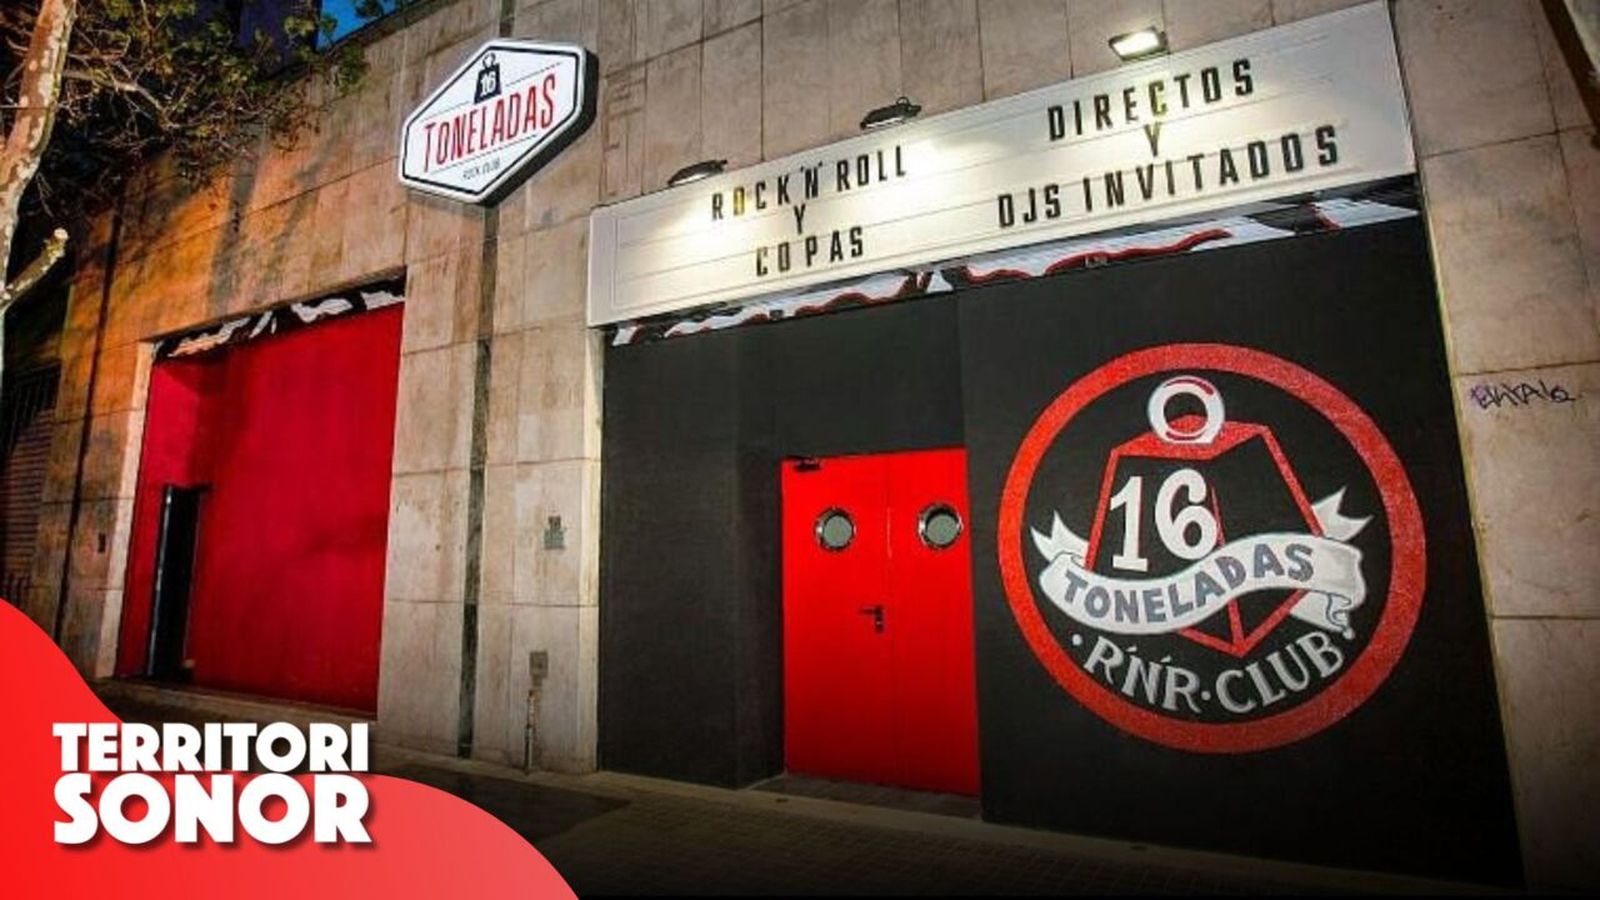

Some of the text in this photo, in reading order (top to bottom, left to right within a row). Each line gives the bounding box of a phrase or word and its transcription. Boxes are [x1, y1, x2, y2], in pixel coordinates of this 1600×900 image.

[424, 73, 556, 173] TONELADAS
[480, 71, 496, 95] 16
[1048, 58, 1254, 141] DIRECTOS
[998, 124, 1339, 228] DJS INVITADOS
[1144, 122, 1162, 157] Y
[756, 226, 863, 277] COPAS
[794, 203, 806, 234] Y
[1109, 468, 1220, 572] 16
[1062, 543, 1315, 624] TONELADAS
[1215, 630, 1346, 714] CLUB
